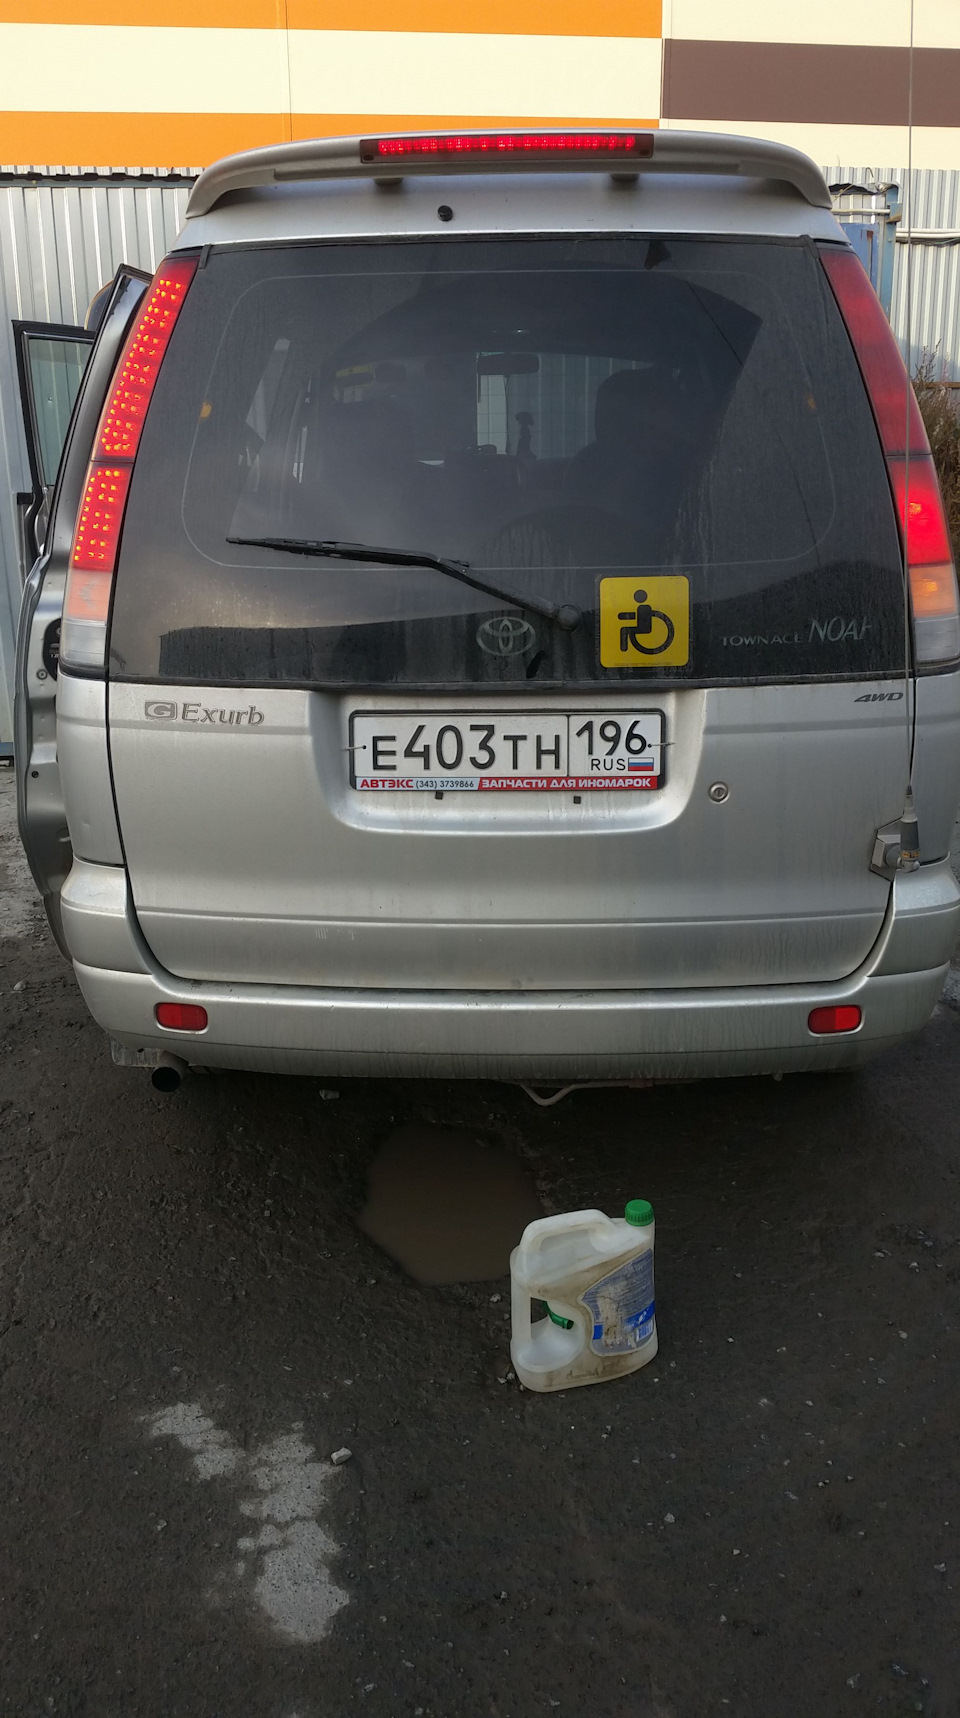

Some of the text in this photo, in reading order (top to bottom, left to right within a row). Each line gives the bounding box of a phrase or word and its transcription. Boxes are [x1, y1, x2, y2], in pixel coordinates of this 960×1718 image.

[854, 692, 904, 703] 4WD
[181, 702, 265, 725] Exurb
[575, 720, 647, 755] 196
[372, 724, 560, 770] Е403ТН
[590, 758, 626, 771] RUS
[360, 779, 475, 789] АВТЭКС (343) 3739866
[482, 778, 652, 788] ЗАПЧАСТИ ДЛЯ ИНОМАРОК
